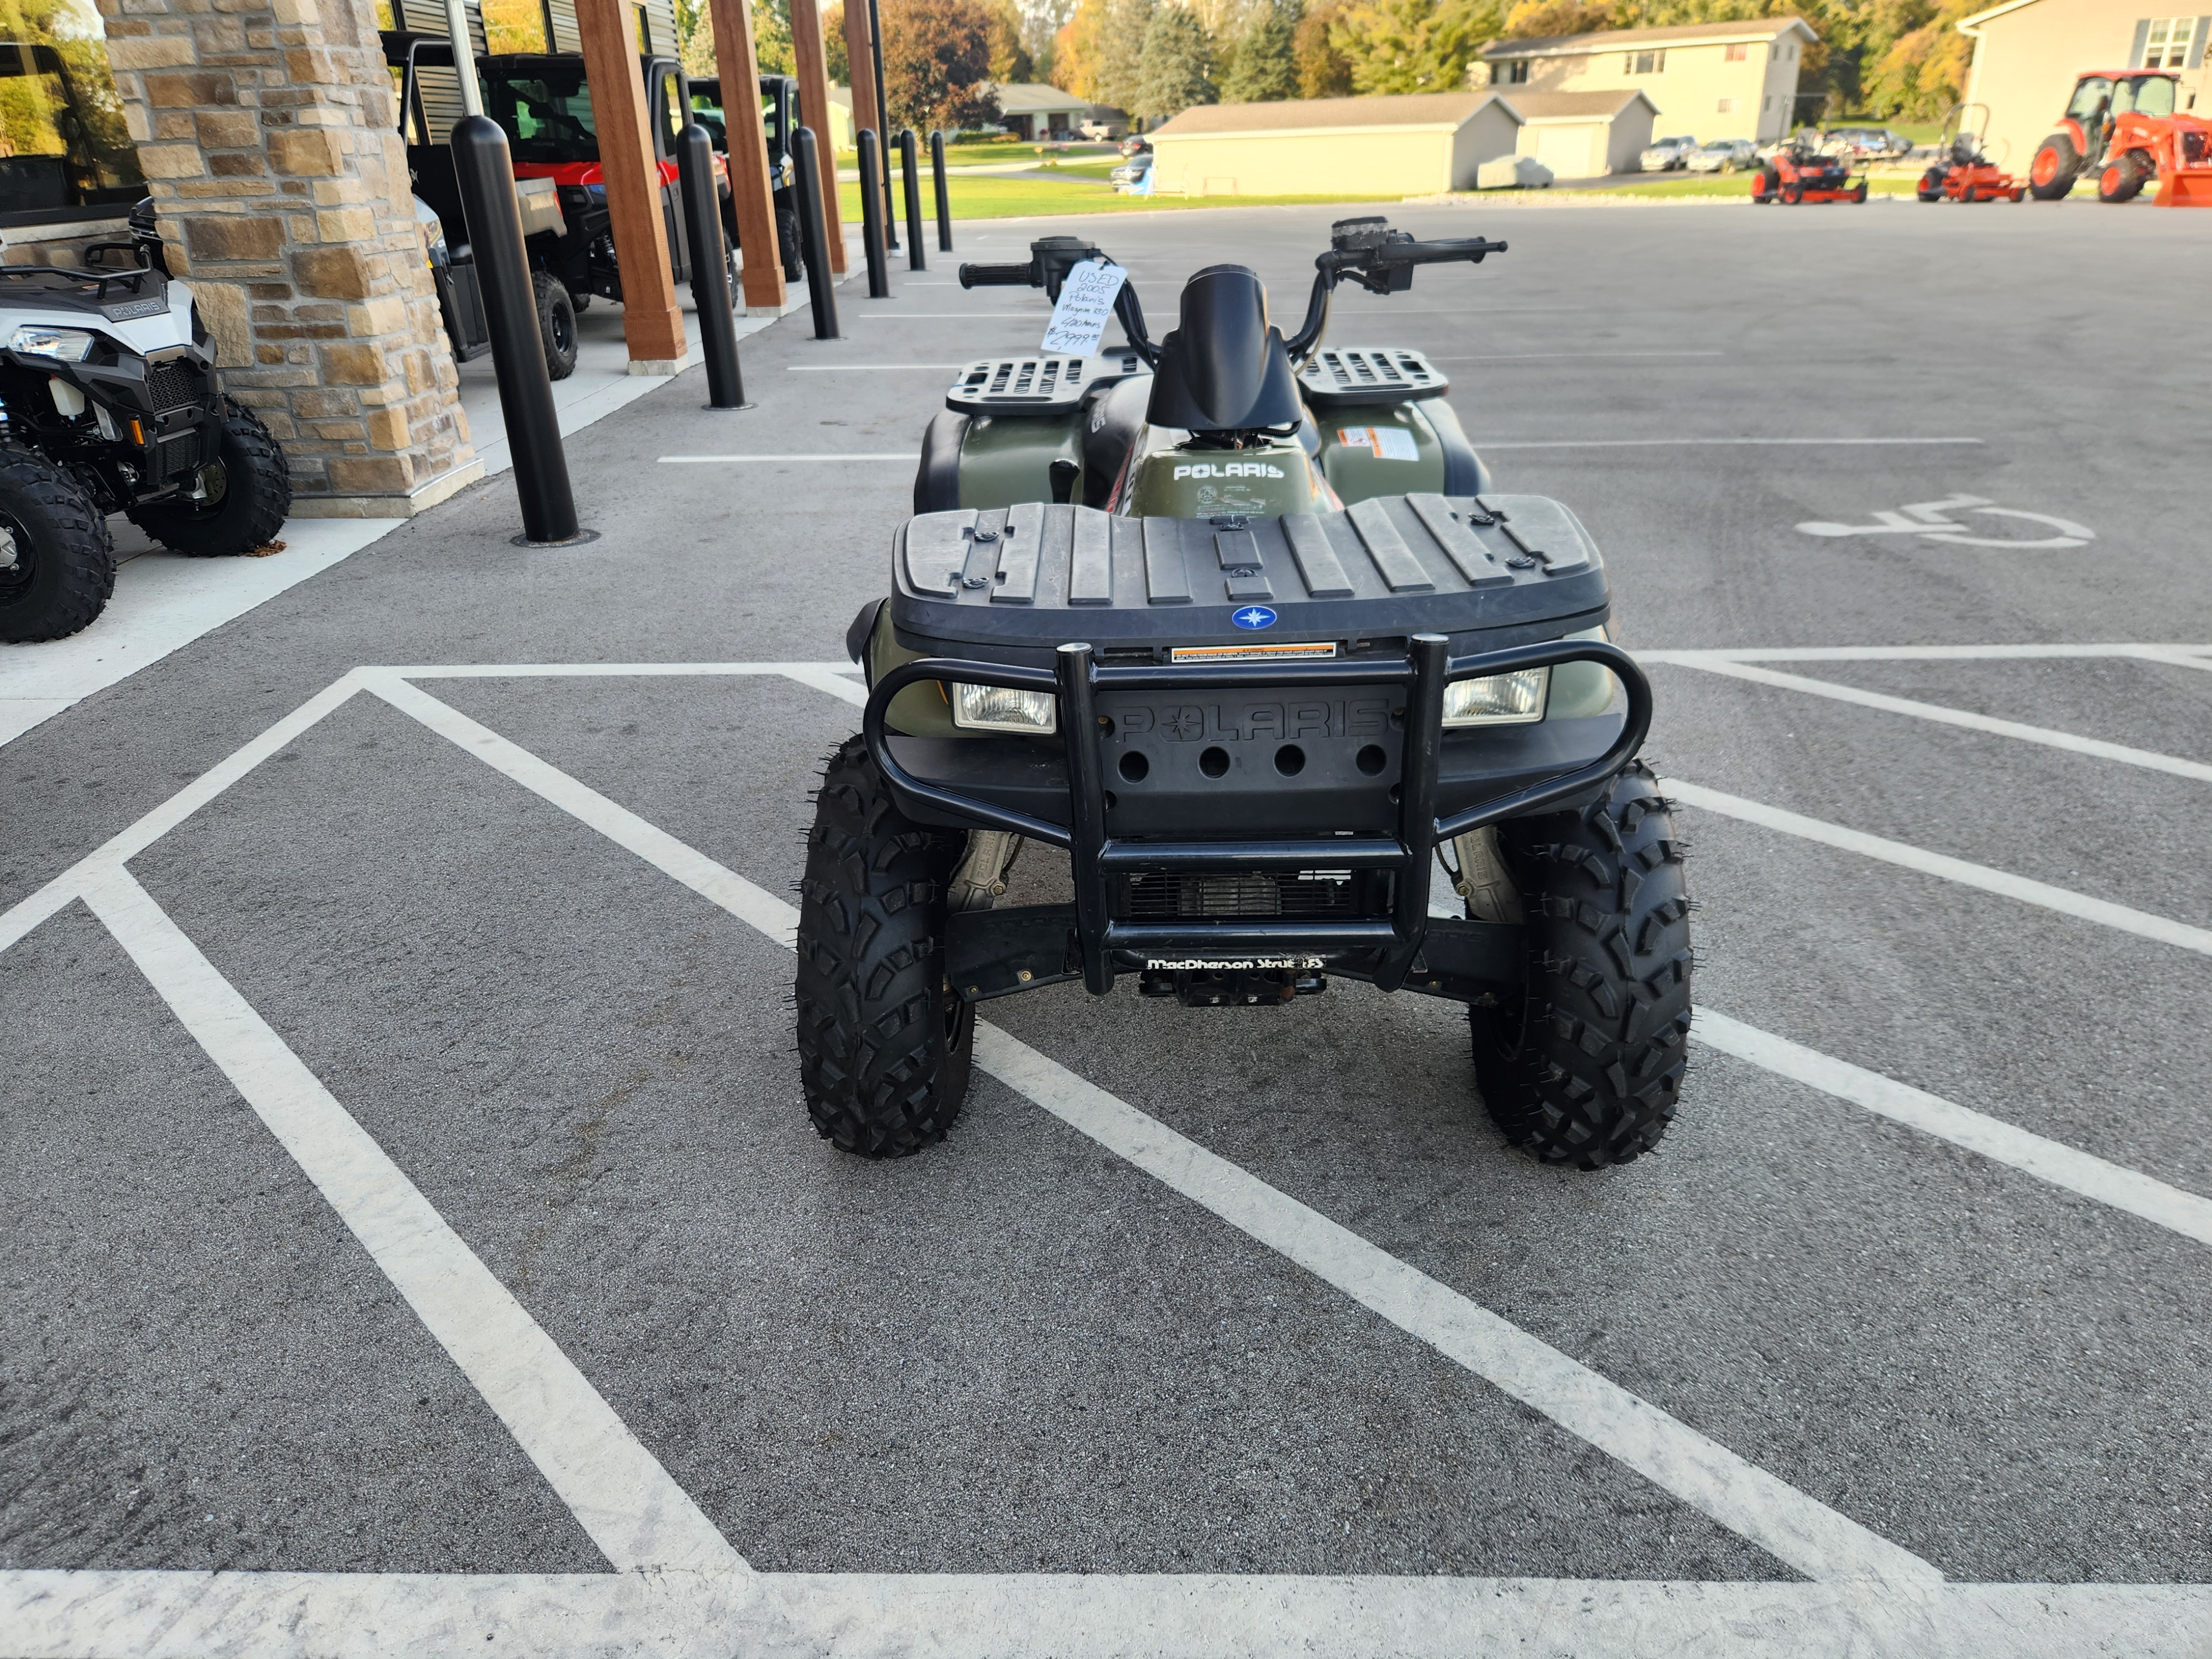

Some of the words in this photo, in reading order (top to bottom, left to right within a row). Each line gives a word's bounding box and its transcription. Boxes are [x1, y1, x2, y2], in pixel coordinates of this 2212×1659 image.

[1079, 270, 1119, 286] USED
[1077, 283, 1111, 294] 2005
[1068, 291, 1105, 305] Polaris
[112, 301, 160, 317] POLARIS
[1062, 303, 1091, 316] Magnum
[1093, 307, 1109, 316] 330
[1173, 462, 1285, 481] POLARIS
[1114, 698, 1389, 742] POLARIS
